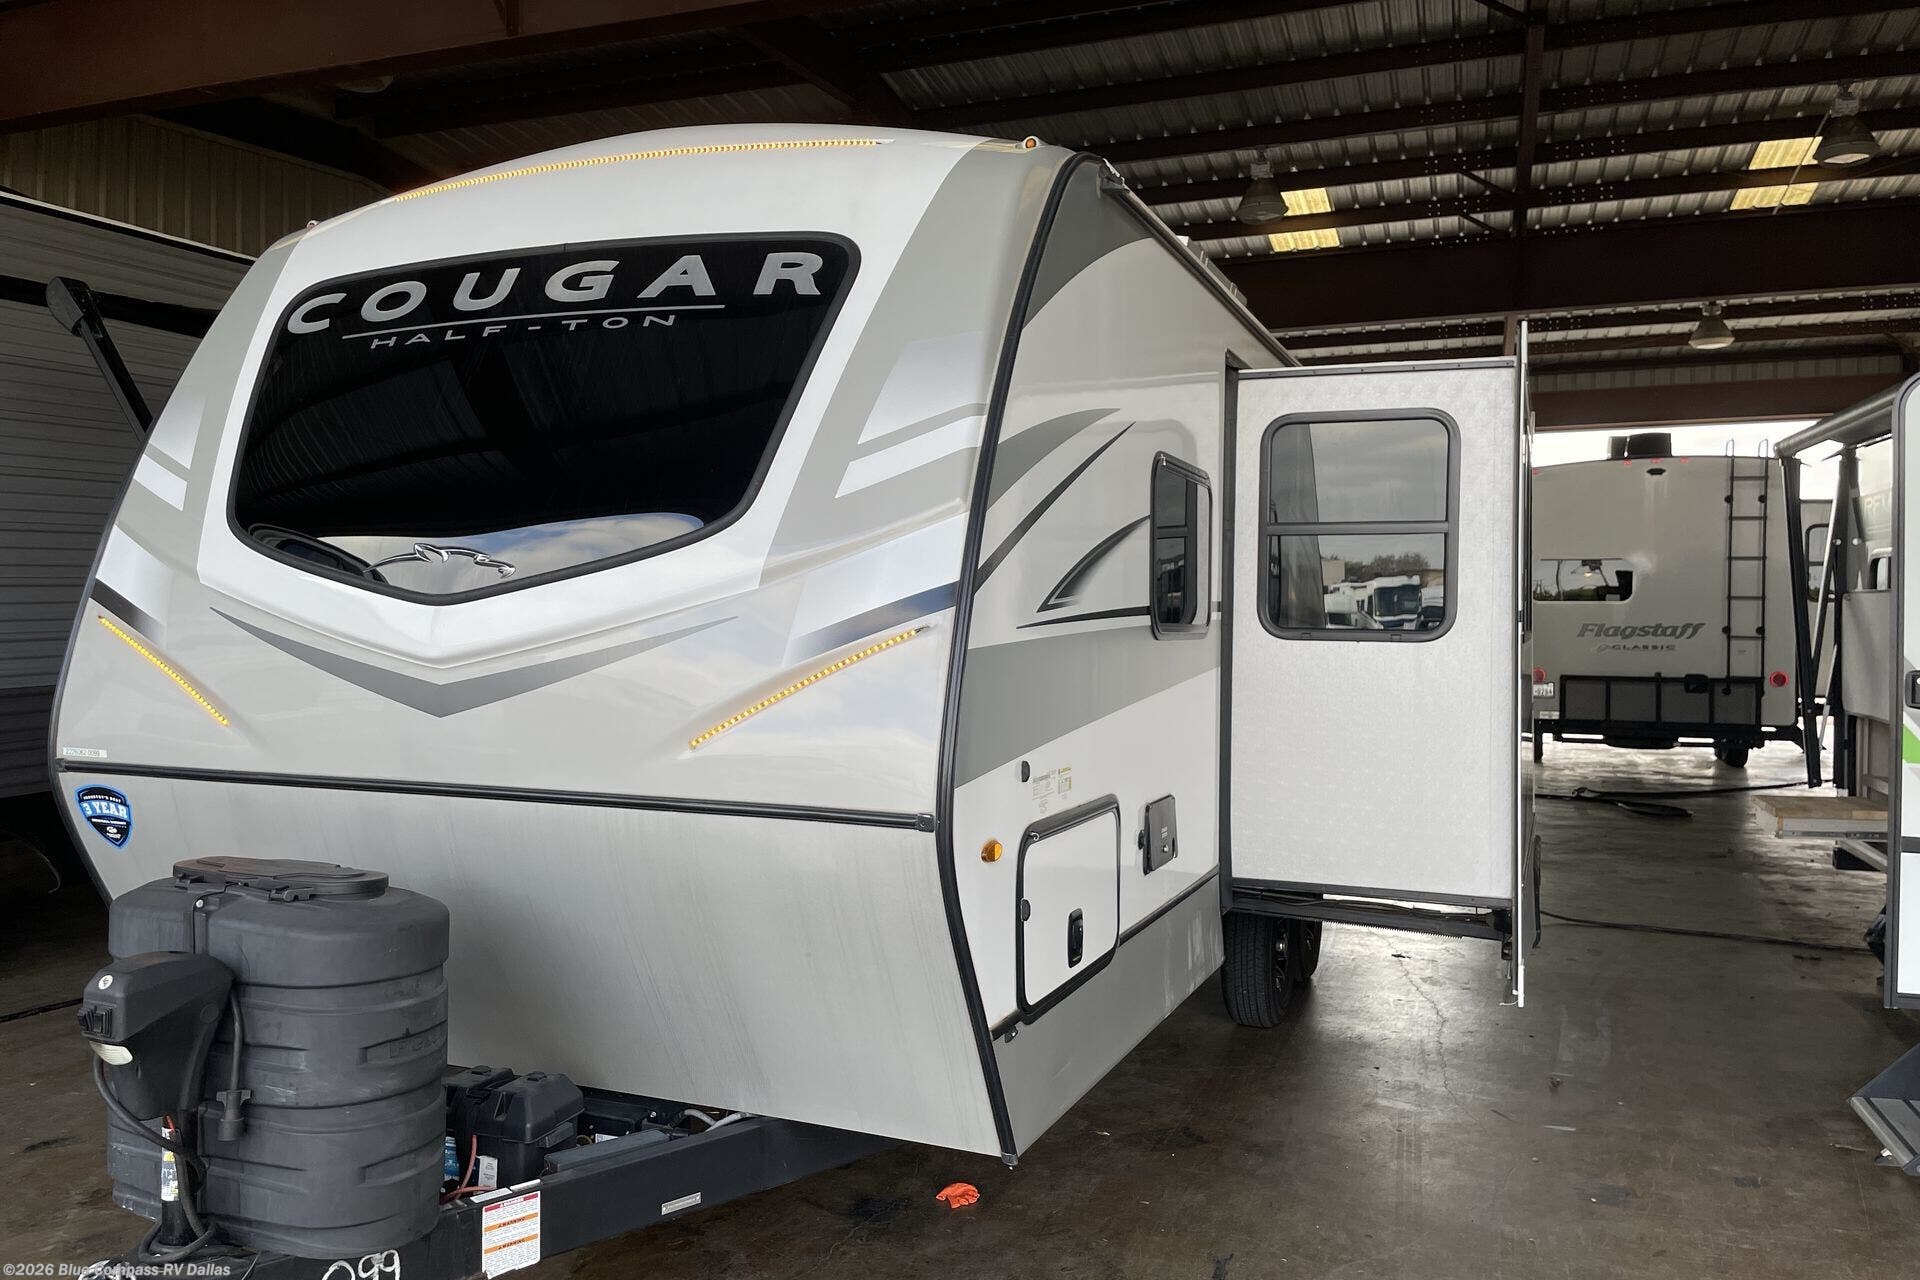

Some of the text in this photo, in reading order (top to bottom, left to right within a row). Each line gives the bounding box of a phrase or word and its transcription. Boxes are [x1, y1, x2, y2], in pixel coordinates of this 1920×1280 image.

[287, 251, 824, 335] COUGAR
[1577, 622, 1706, 640] Flagstaff
[1612, 643, 1677, 651] CLASSIC
[82, 801, 128, 819] 3 YEAR
